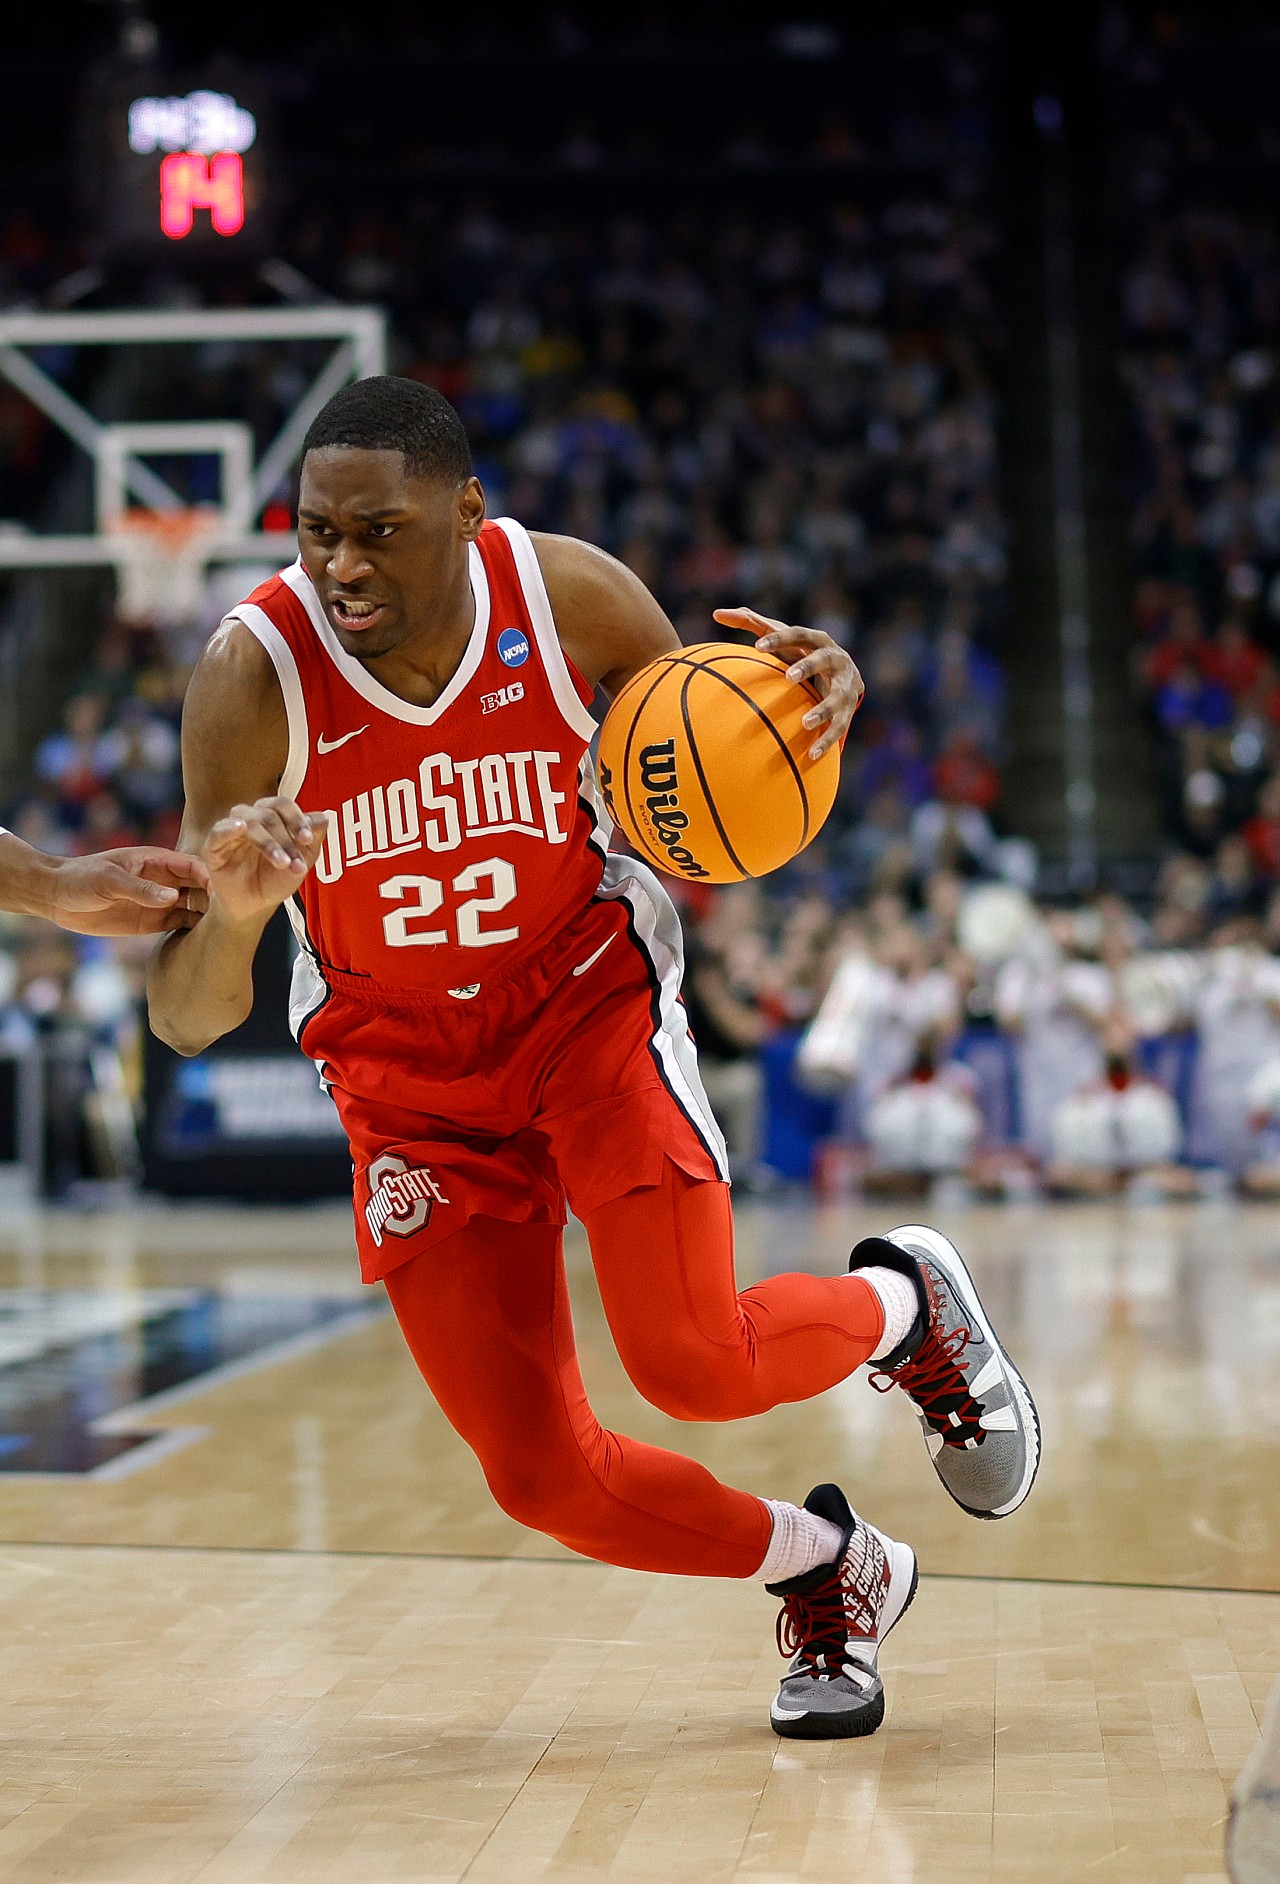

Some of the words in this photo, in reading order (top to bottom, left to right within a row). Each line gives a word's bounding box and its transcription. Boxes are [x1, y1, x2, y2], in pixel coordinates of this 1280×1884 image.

[503, 641, 529, 661] NCAA
[639, 737, 710, 877] Wilson
[639, 804, 650, 826] EVO
[646, 827, 660, 847] NXT
[378, 856, 520, 948] 22
